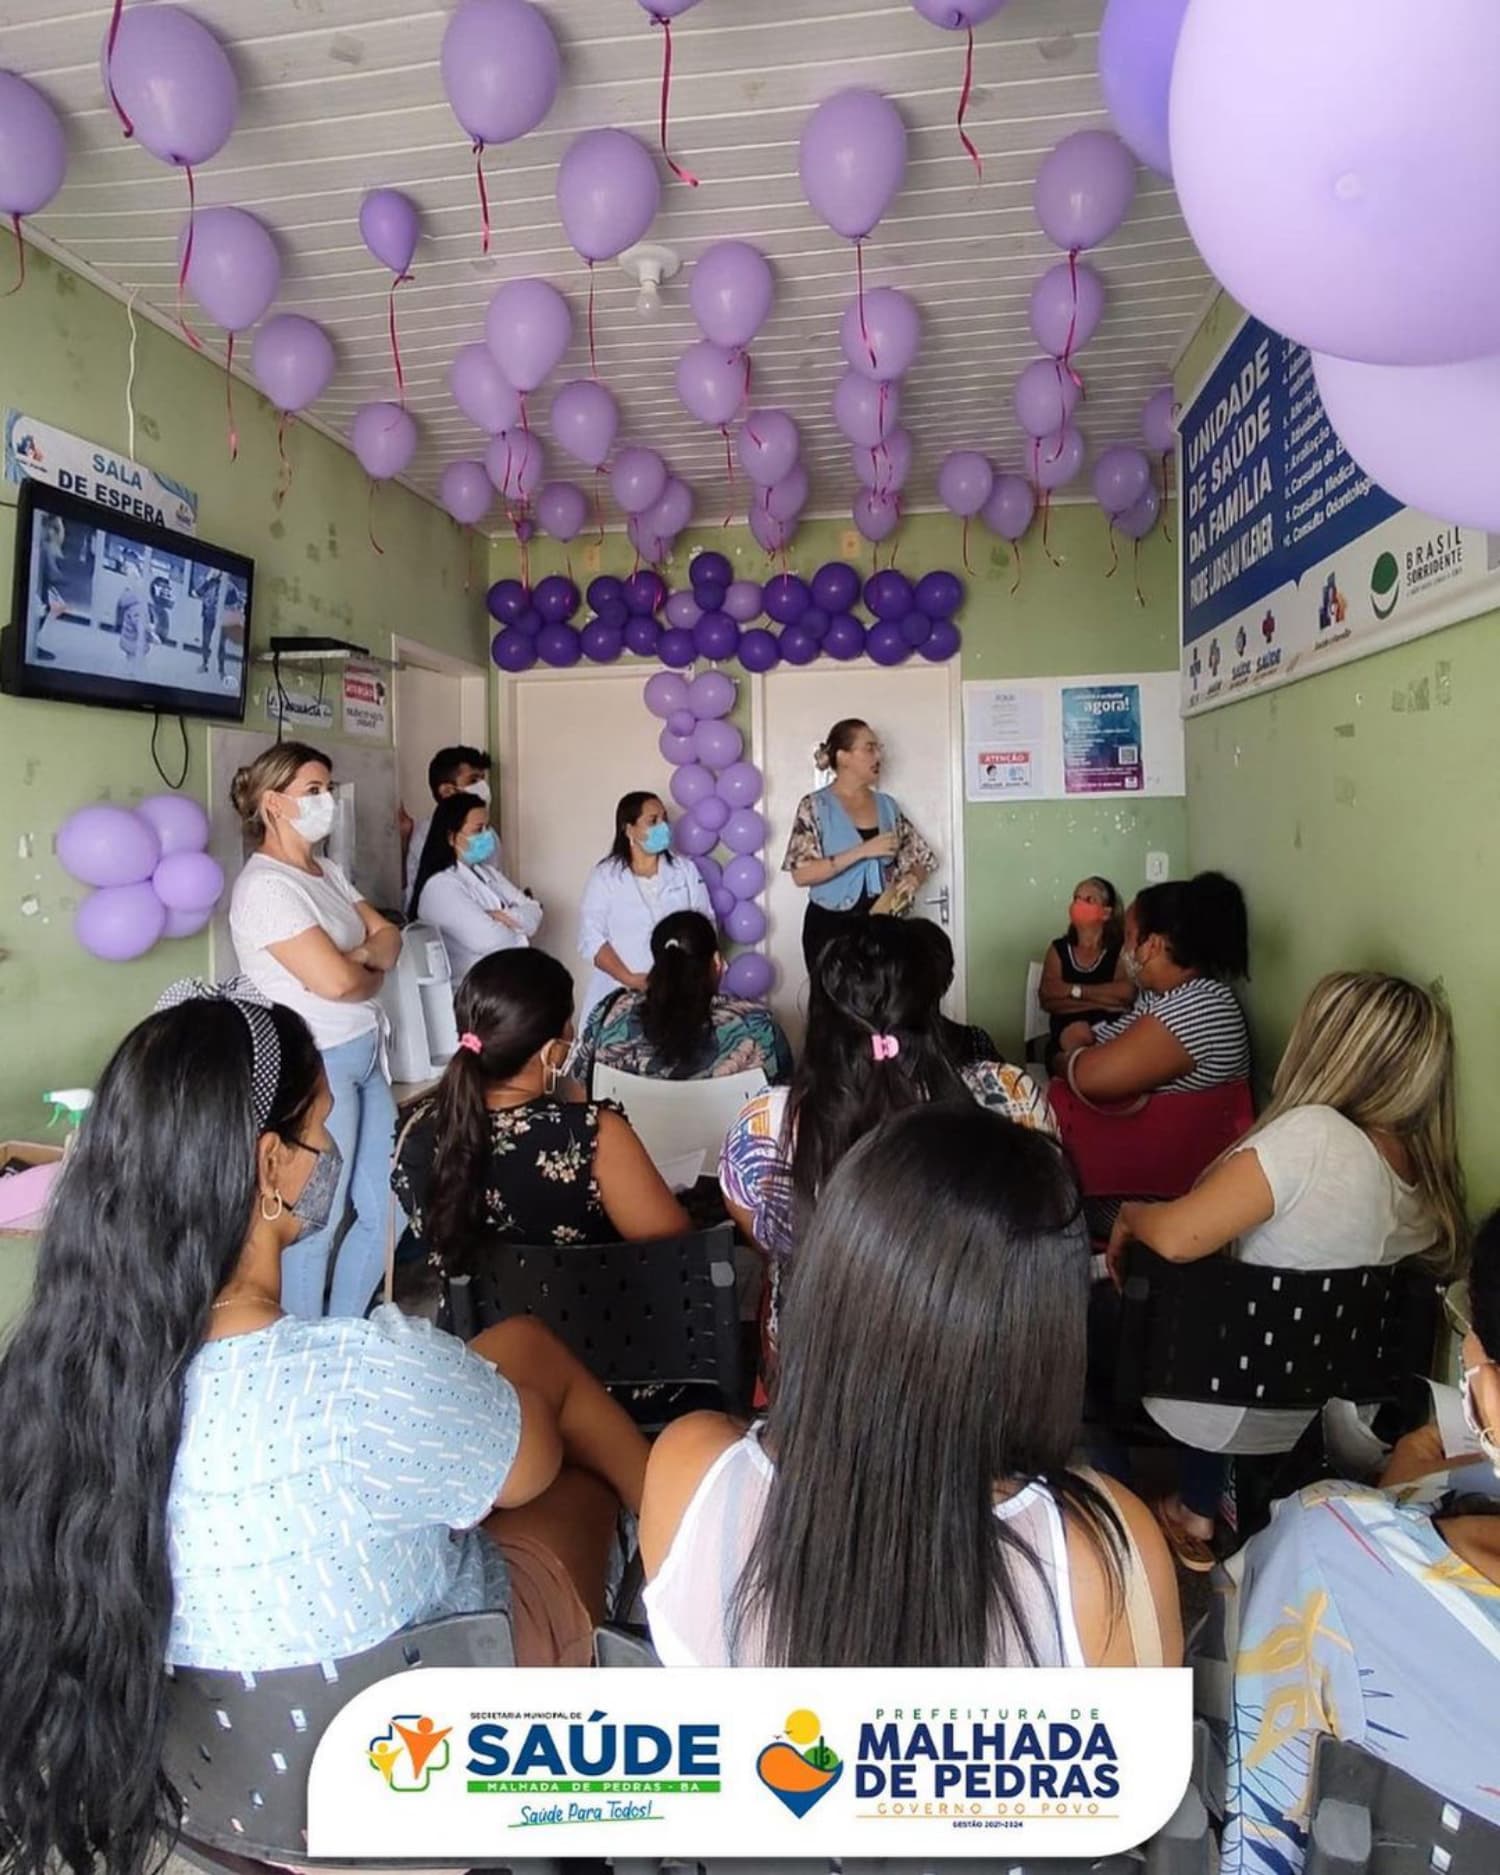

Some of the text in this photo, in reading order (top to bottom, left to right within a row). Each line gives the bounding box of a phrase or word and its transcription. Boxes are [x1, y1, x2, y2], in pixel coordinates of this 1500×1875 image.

[1188, 337, 1270, 473] UNIDADE
[92, 453, 143, 490] SALA
[1189, 394, 1271, 519] DE SAÚDE
[58, 469, 166, 528] DE ESPERA
[1189, 456, 1272, 564] DA FAMÍLIA
[1405, 525, 1462, 570] BRASIL
[1406, 547, 1463, 586] SORRIDENTE
[1083, 696, 1130, 715] agora!
